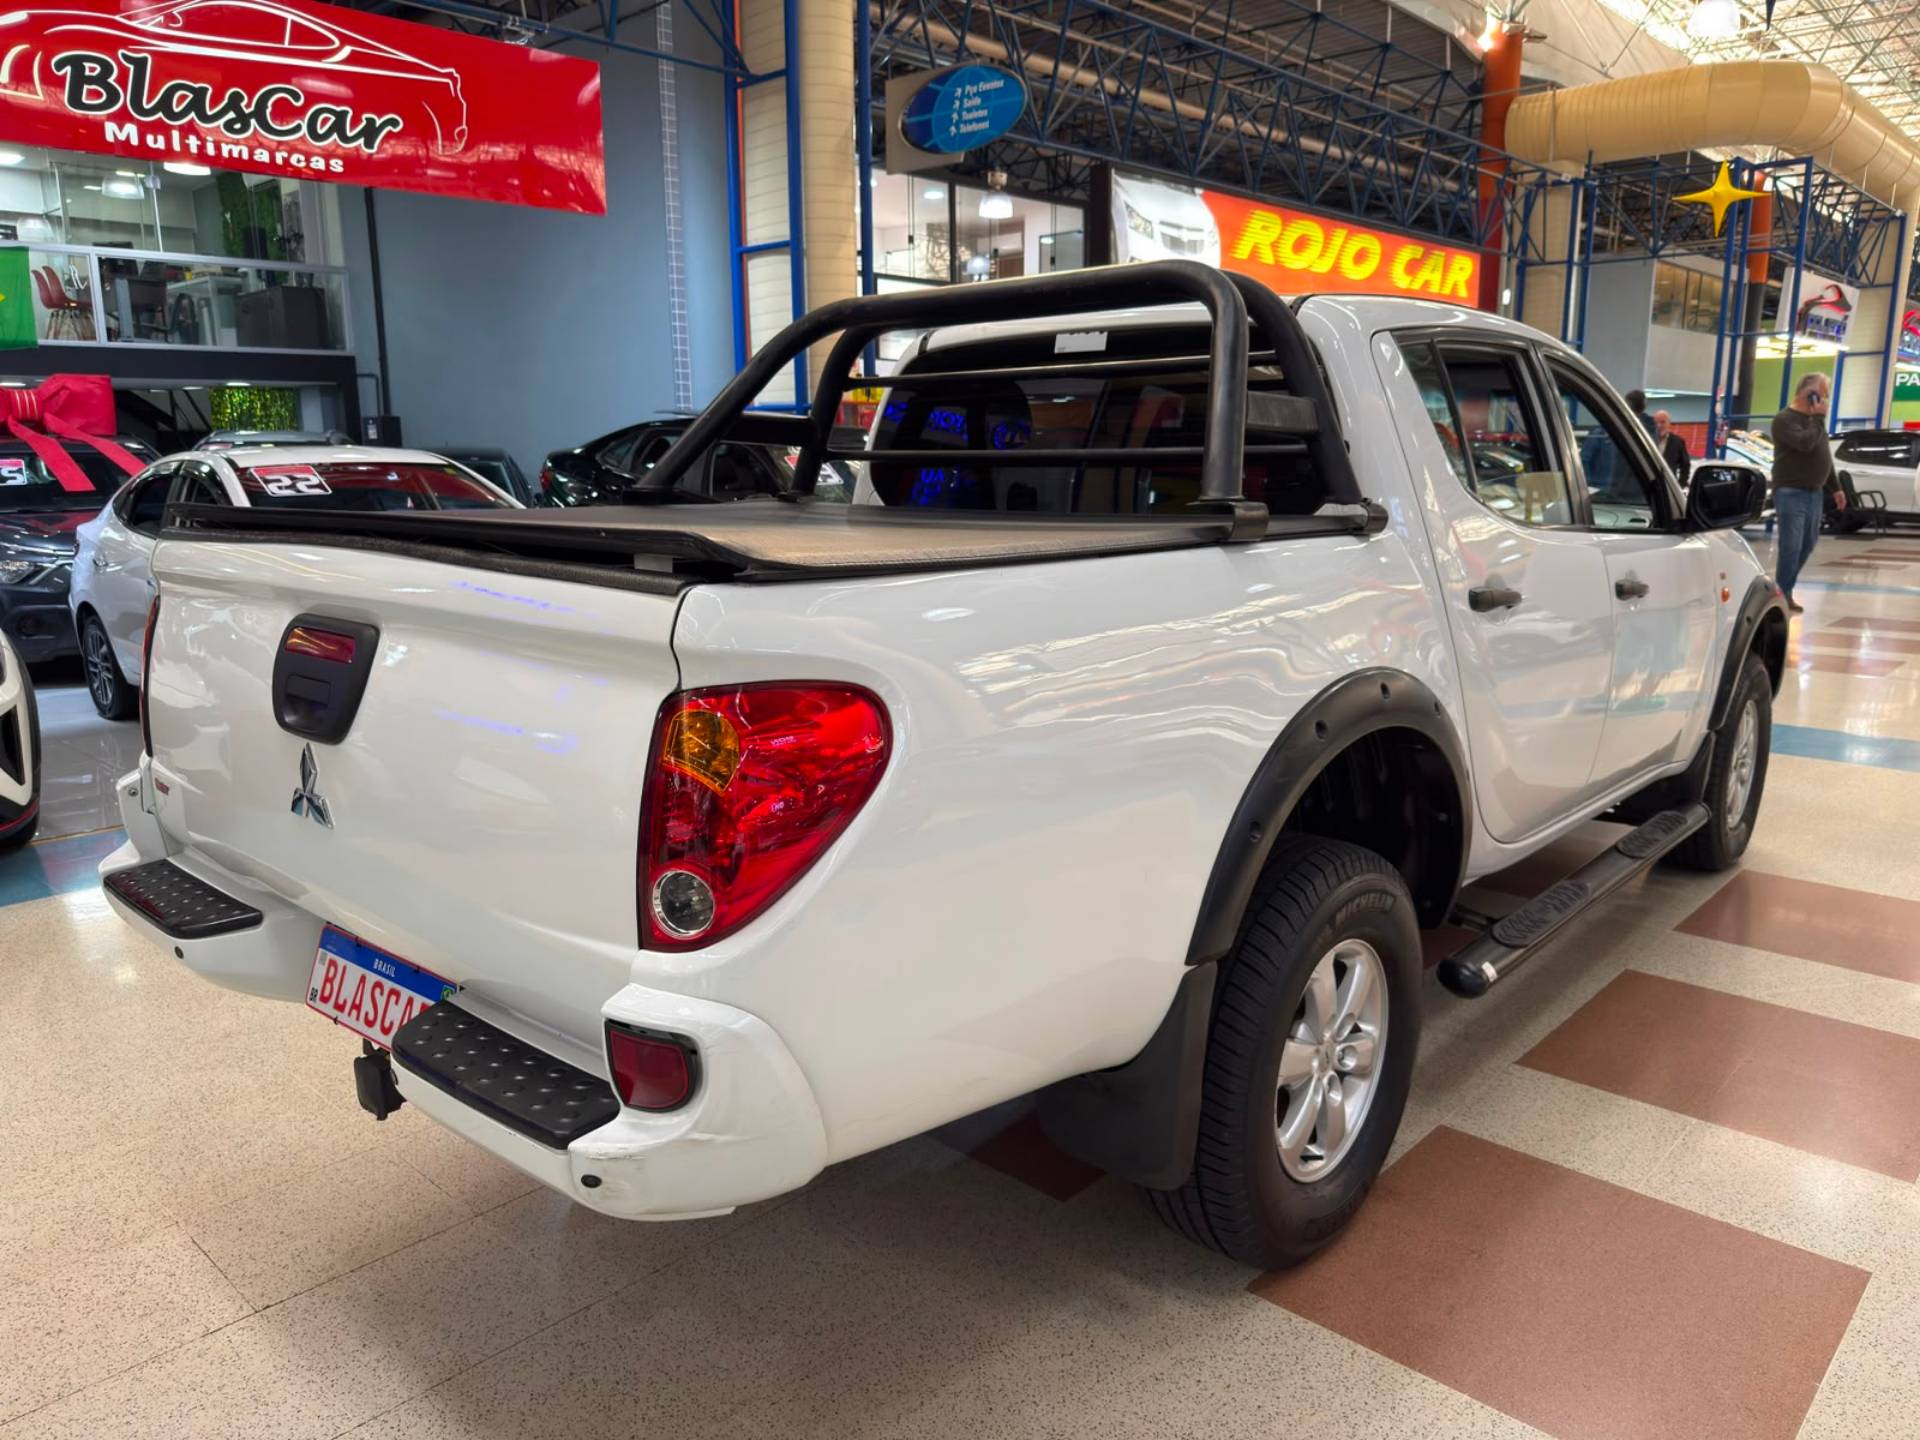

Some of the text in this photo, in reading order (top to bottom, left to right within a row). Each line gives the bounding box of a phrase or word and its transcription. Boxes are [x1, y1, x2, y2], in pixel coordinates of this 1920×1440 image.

[51, 49, 402, 152] BlasCar
[104, 121, 345, 174] Multimarcas
[1231, 209, 1475, 298] ROJO CAR
[263, 474, 327, 495] 22
[373, 958, 397, 978] BRASIL
